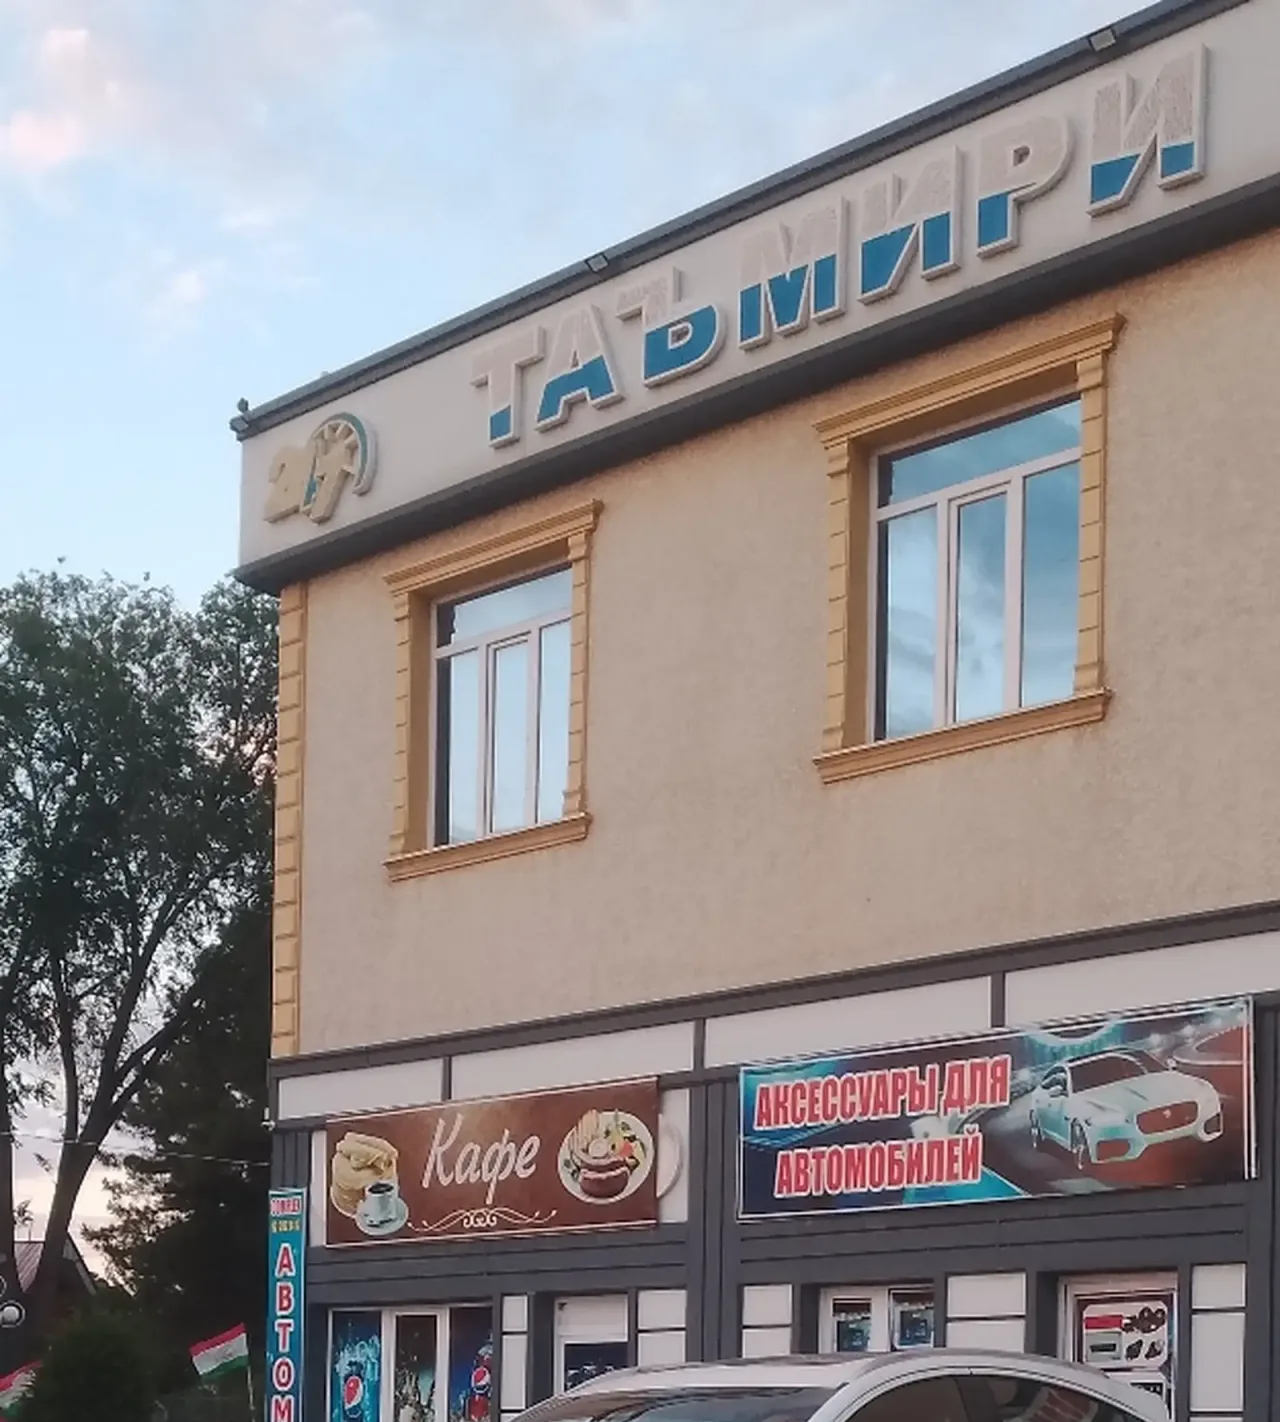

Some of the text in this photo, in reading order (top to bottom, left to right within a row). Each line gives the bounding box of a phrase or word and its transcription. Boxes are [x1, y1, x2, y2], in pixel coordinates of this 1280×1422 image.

[472, 43, 1208, 448] ТАЪМИРИ
[753, 1053, 1011, 1130] АКСЕССУАРЫ ДЛЯ
[422, 1112, 542, 1204] Кафе
[774, 1124, 982, 1198] АВТОМОБИЛЕЙ
